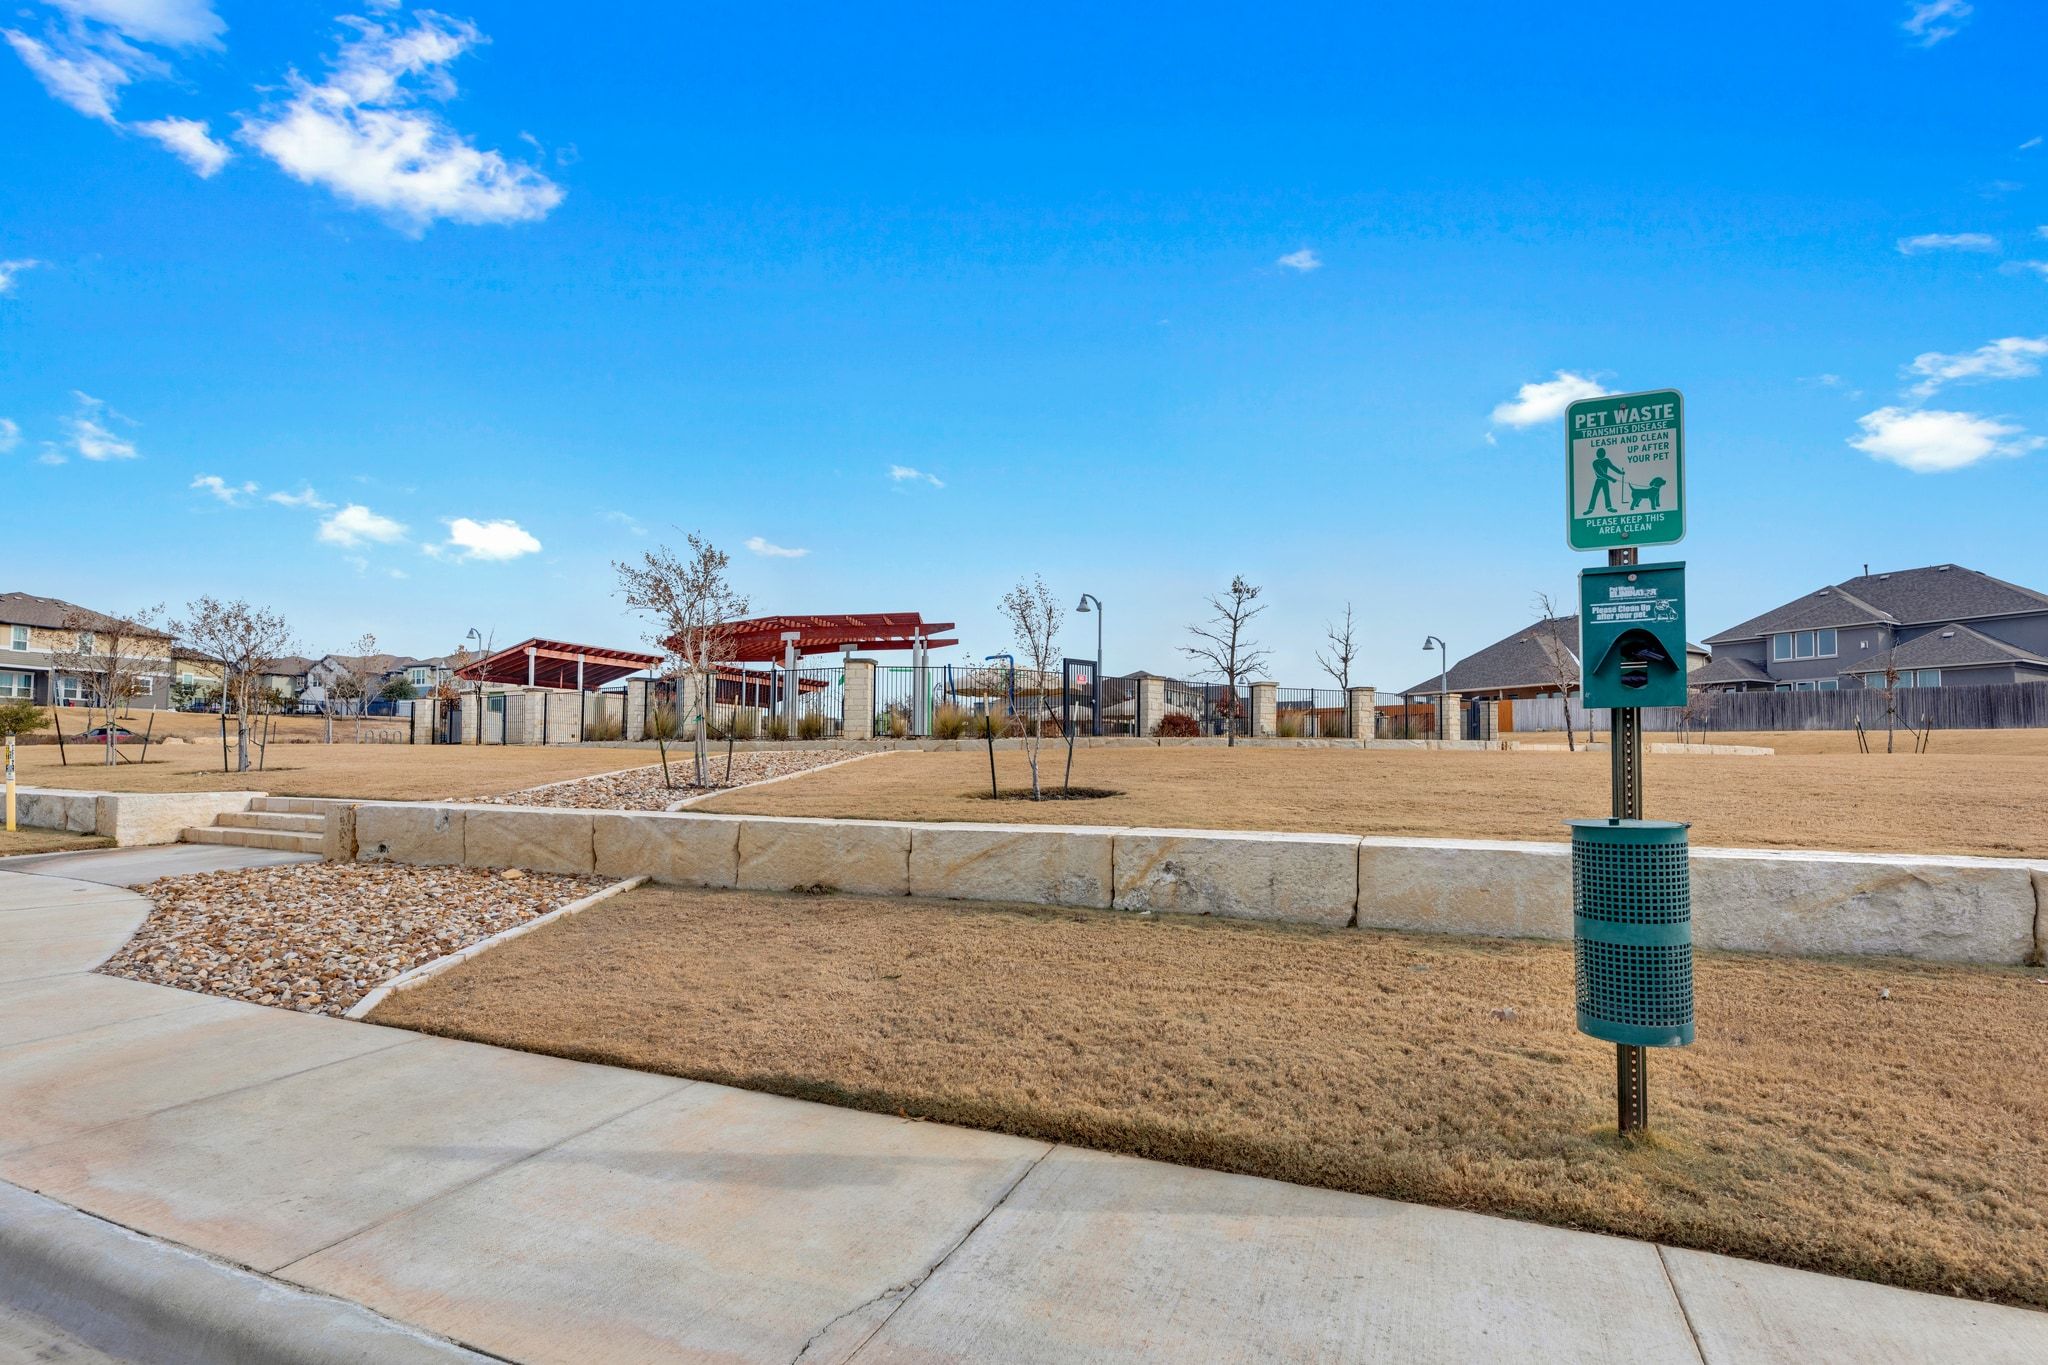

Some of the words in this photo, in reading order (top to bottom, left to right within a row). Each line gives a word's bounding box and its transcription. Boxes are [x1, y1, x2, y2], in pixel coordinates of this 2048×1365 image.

[1575, 411, 1608, 429] PET
[1613, 403, 1675, 425] WASTE
[1582, 425, 1630, 438] TRANSMITS
[1631, 421, 1668, 432] DISEASE
[1590, 437, 1618, 448] LEASH
[1620, 435, 1638, 444] AND
[1640, 432, 1669, 442] CLEAN
[1627, 445, 1639, 453] UP
[1641, 442, 1670, 452] AFTER
[1627, 454, 1651, 464] YOUR
[1653, 452, 1670, 461] PET
[1586, 518, 1618, 528] PLEASE
[1620, 516, 1643, 525] KEEP
[1644, 513, 1665, 522] THIS
[1598, 525, 1621, 535] AREA
[1623, 523, 1652, 532] CLEAN
[1592, 606, 1617, 614] Please
[1618, 604, 1640, 612] Clean
[1596, 612, 1614, 620] after
[1615, 612, 1633, 620] your
[1633, 611, 1648, 619] pet.
